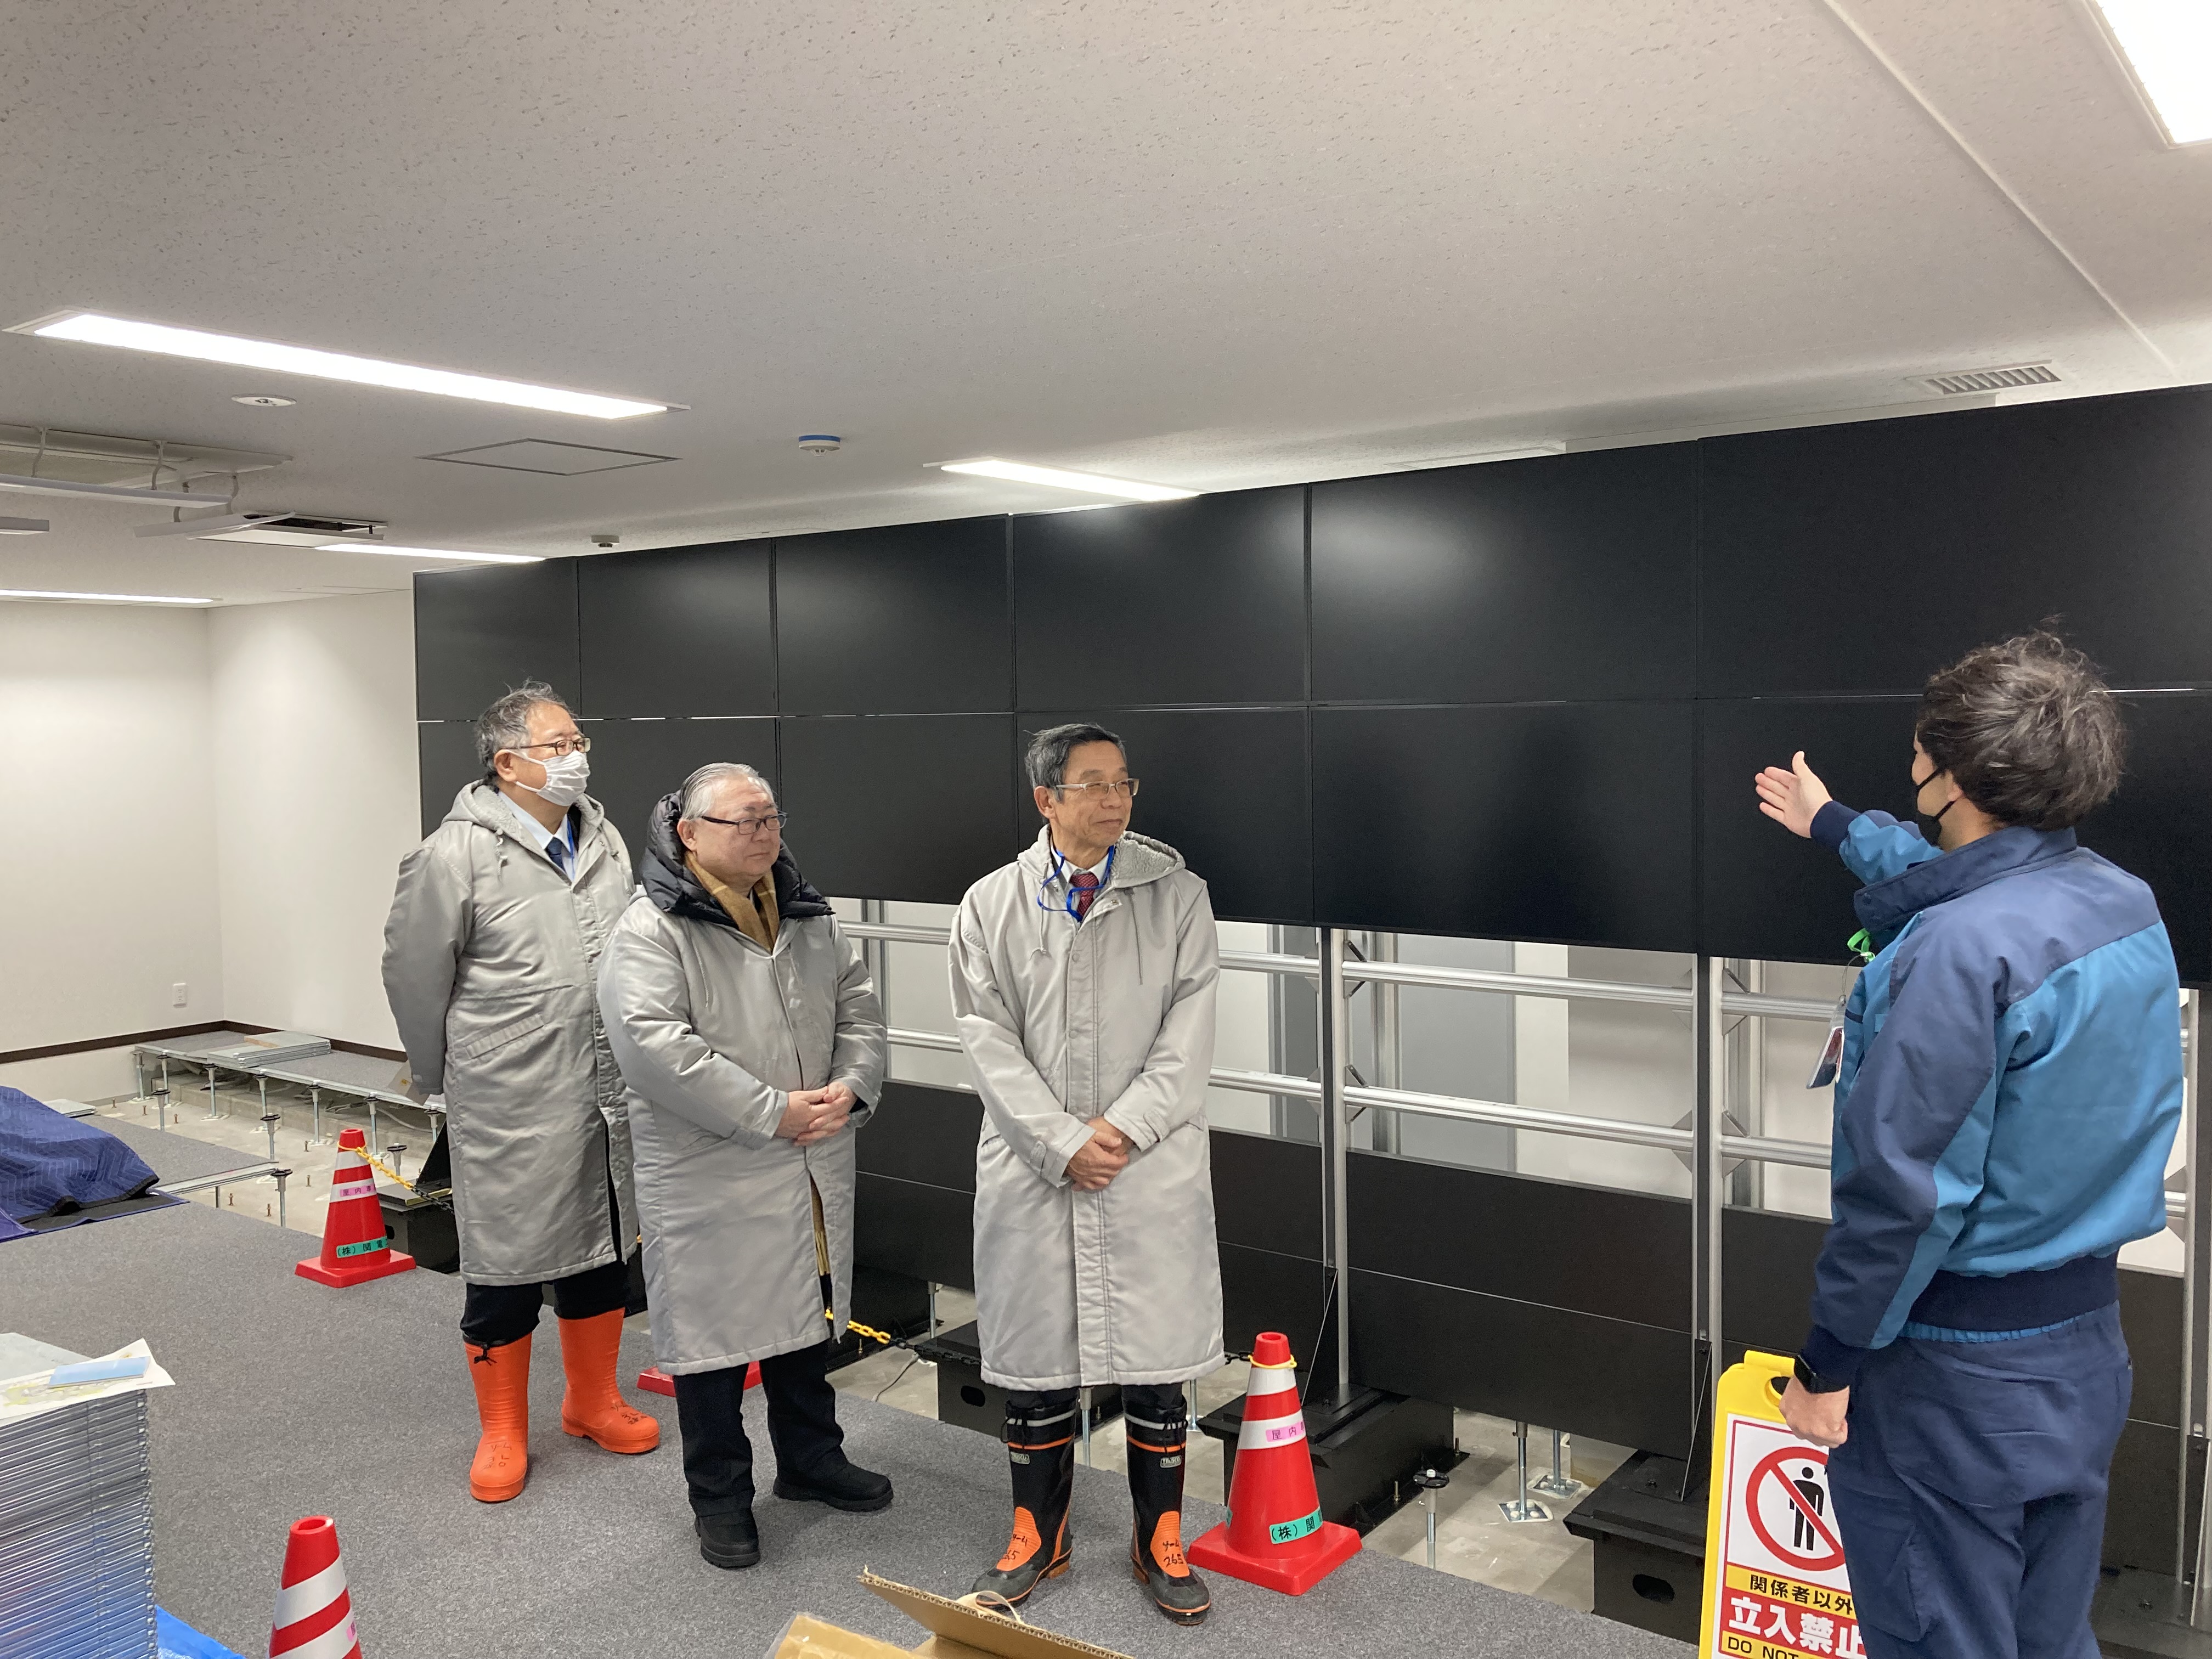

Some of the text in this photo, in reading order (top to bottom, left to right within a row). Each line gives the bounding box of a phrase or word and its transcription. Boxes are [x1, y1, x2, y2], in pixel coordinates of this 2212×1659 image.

[1750, 1574, 1853, 1615] 関係者以外
[1728, 1637, 1752, 1654] DO
[1729, 1596, 1866, 1659] 立入禁止
